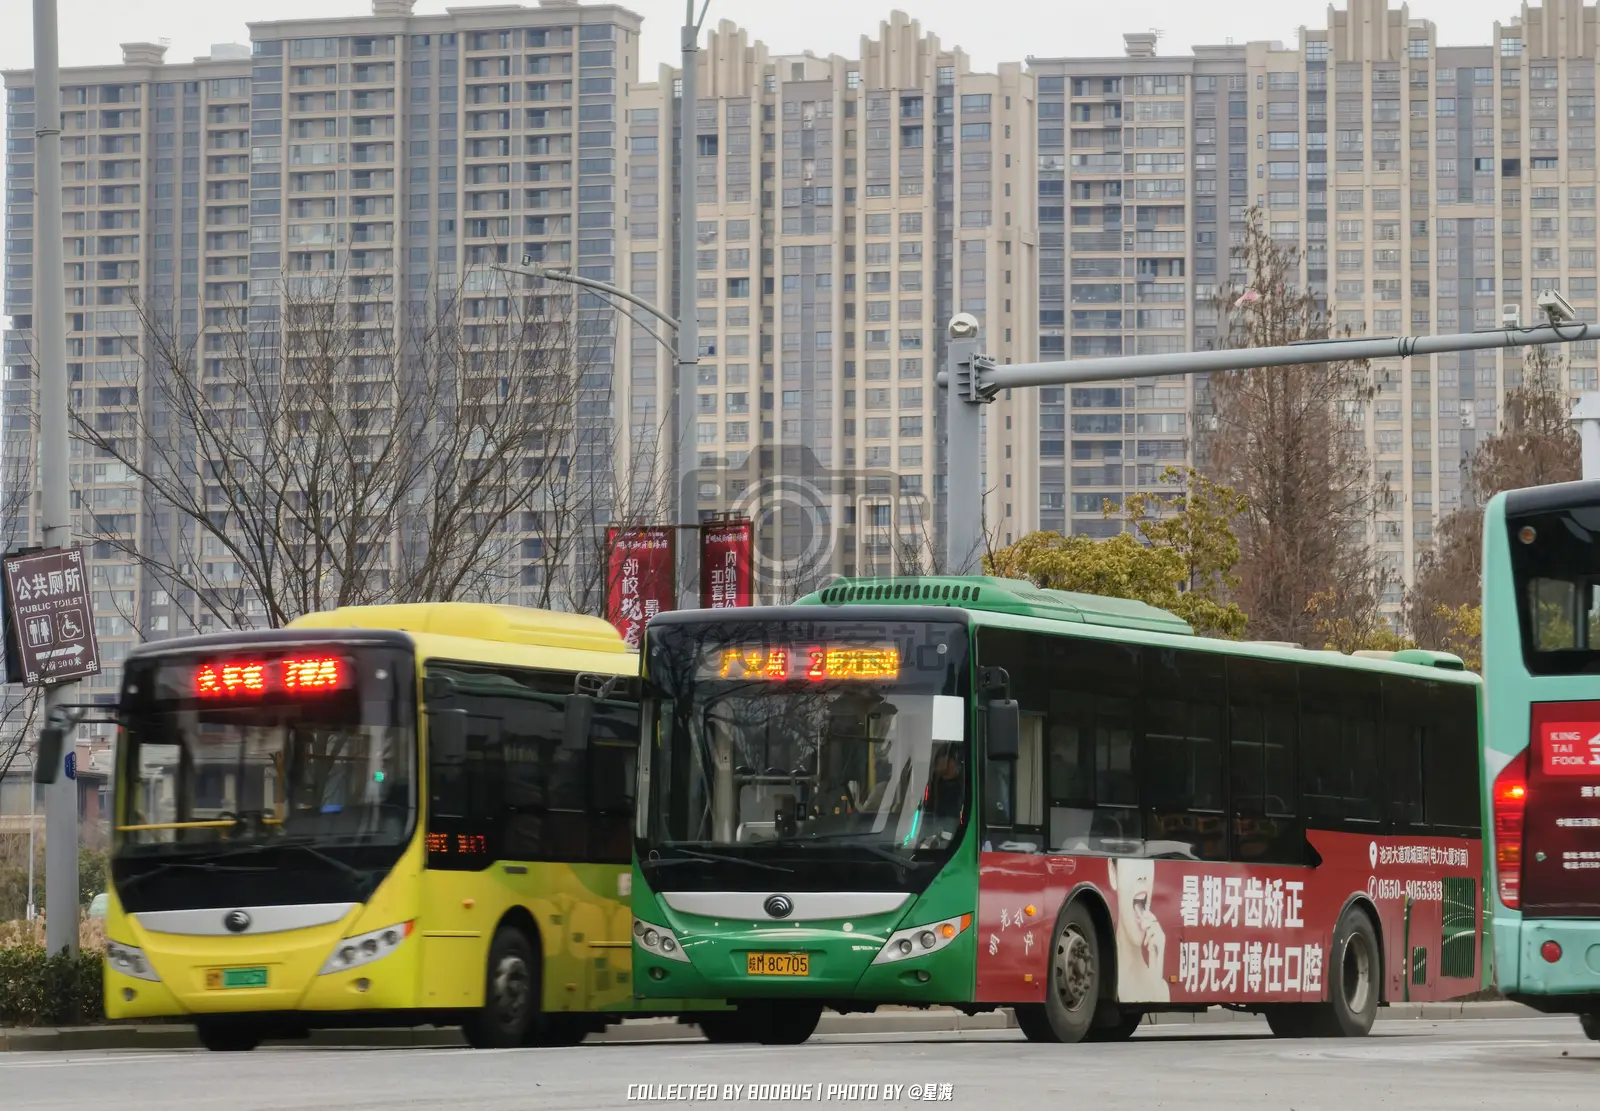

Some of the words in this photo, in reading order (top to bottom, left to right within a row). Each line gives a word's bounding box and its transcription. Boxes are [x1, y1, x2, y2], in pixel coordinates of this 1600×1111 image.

[16, 567, 81, 601] 公共厕所
[19, 601, 51, 614] PUBLIC
[53, 597, 84, 609] TOILET
[809, 651, 824, 676] 2
[1550, 732, 1581, 741] KING
[1551, 744, 1573, 752] TAI
[1551, 756, 1586, 765] FOOK
[1378, 879, 1443, 900] 0550-8055333
[1180, 875, 1304, 928] 暑期牙齿矫正
[1179, 940, 1323, 993] 明光牙博仕口腔
